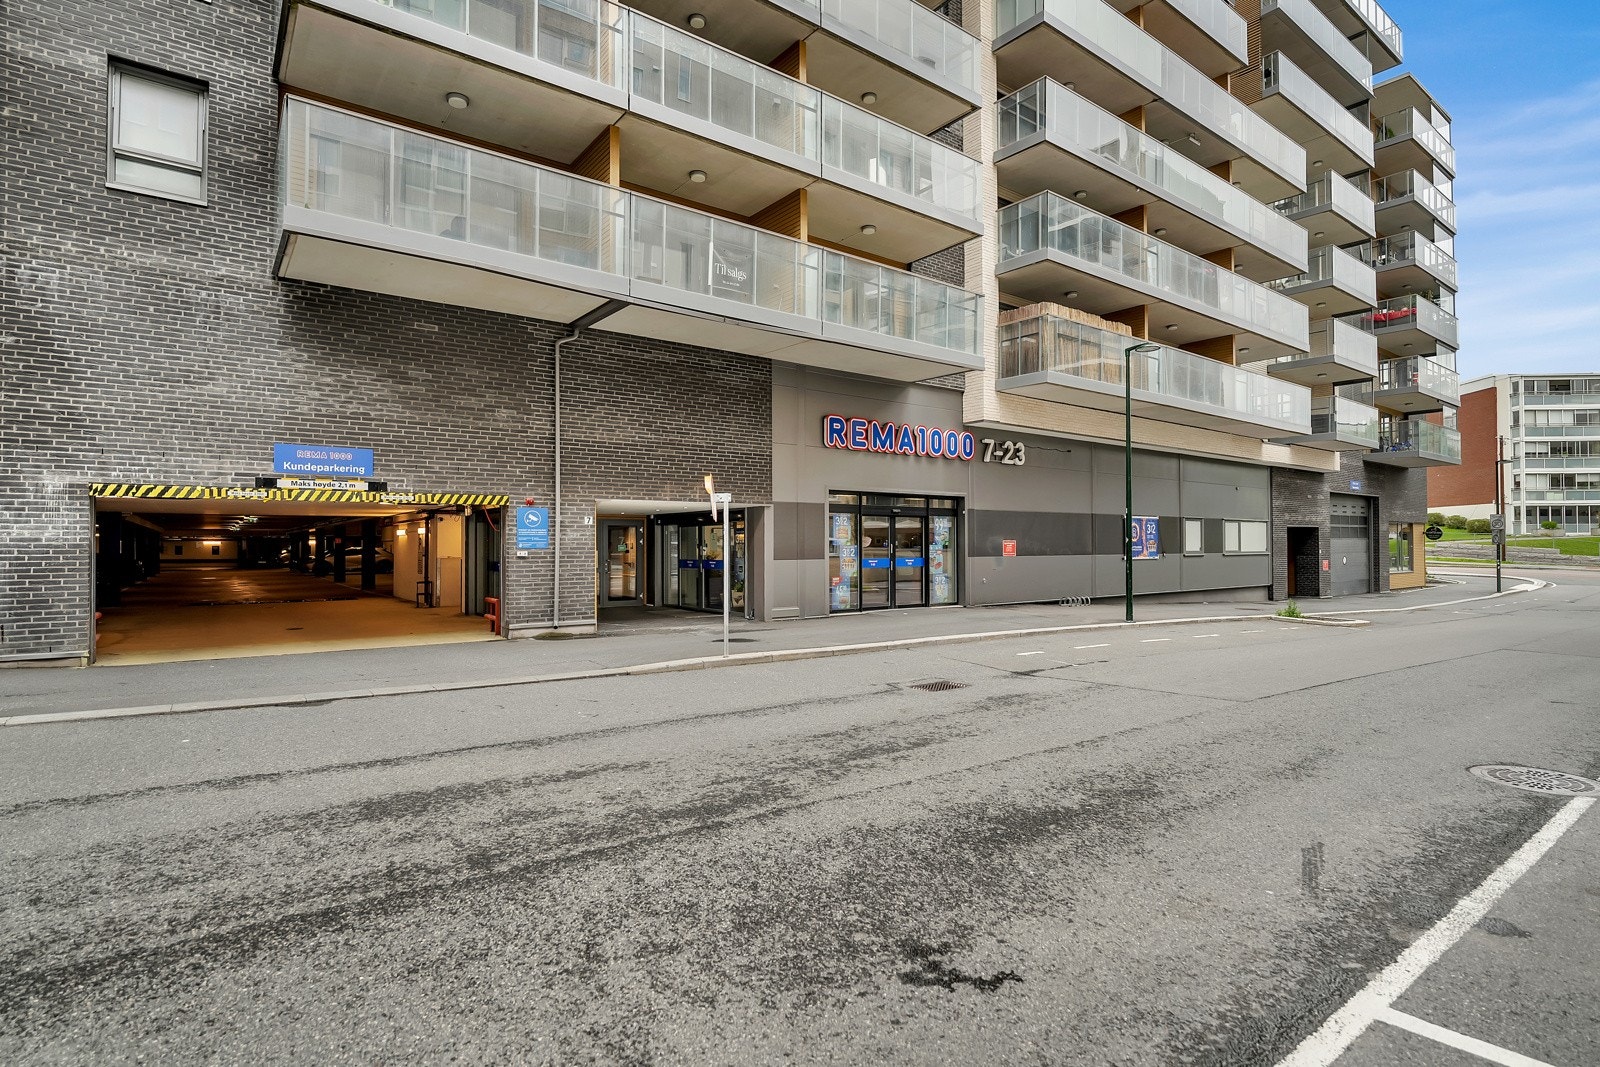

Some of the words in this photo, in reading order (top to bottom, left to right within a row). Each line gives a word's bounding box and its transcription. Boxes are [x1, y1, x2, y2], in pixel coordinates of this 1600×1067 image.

[714, 262, 727, 276] Til
[727, 267, 747, 282] salgs
[297, 450, 328, 460] REMA
[329, 451, 353, 460] 1000
[982, 438, 1026, 466] 7-23
[283, 461, 365, 474] Kundeparkering
[312, 481, 336, 489] høyde
[586, 516, 591, 524] 7
